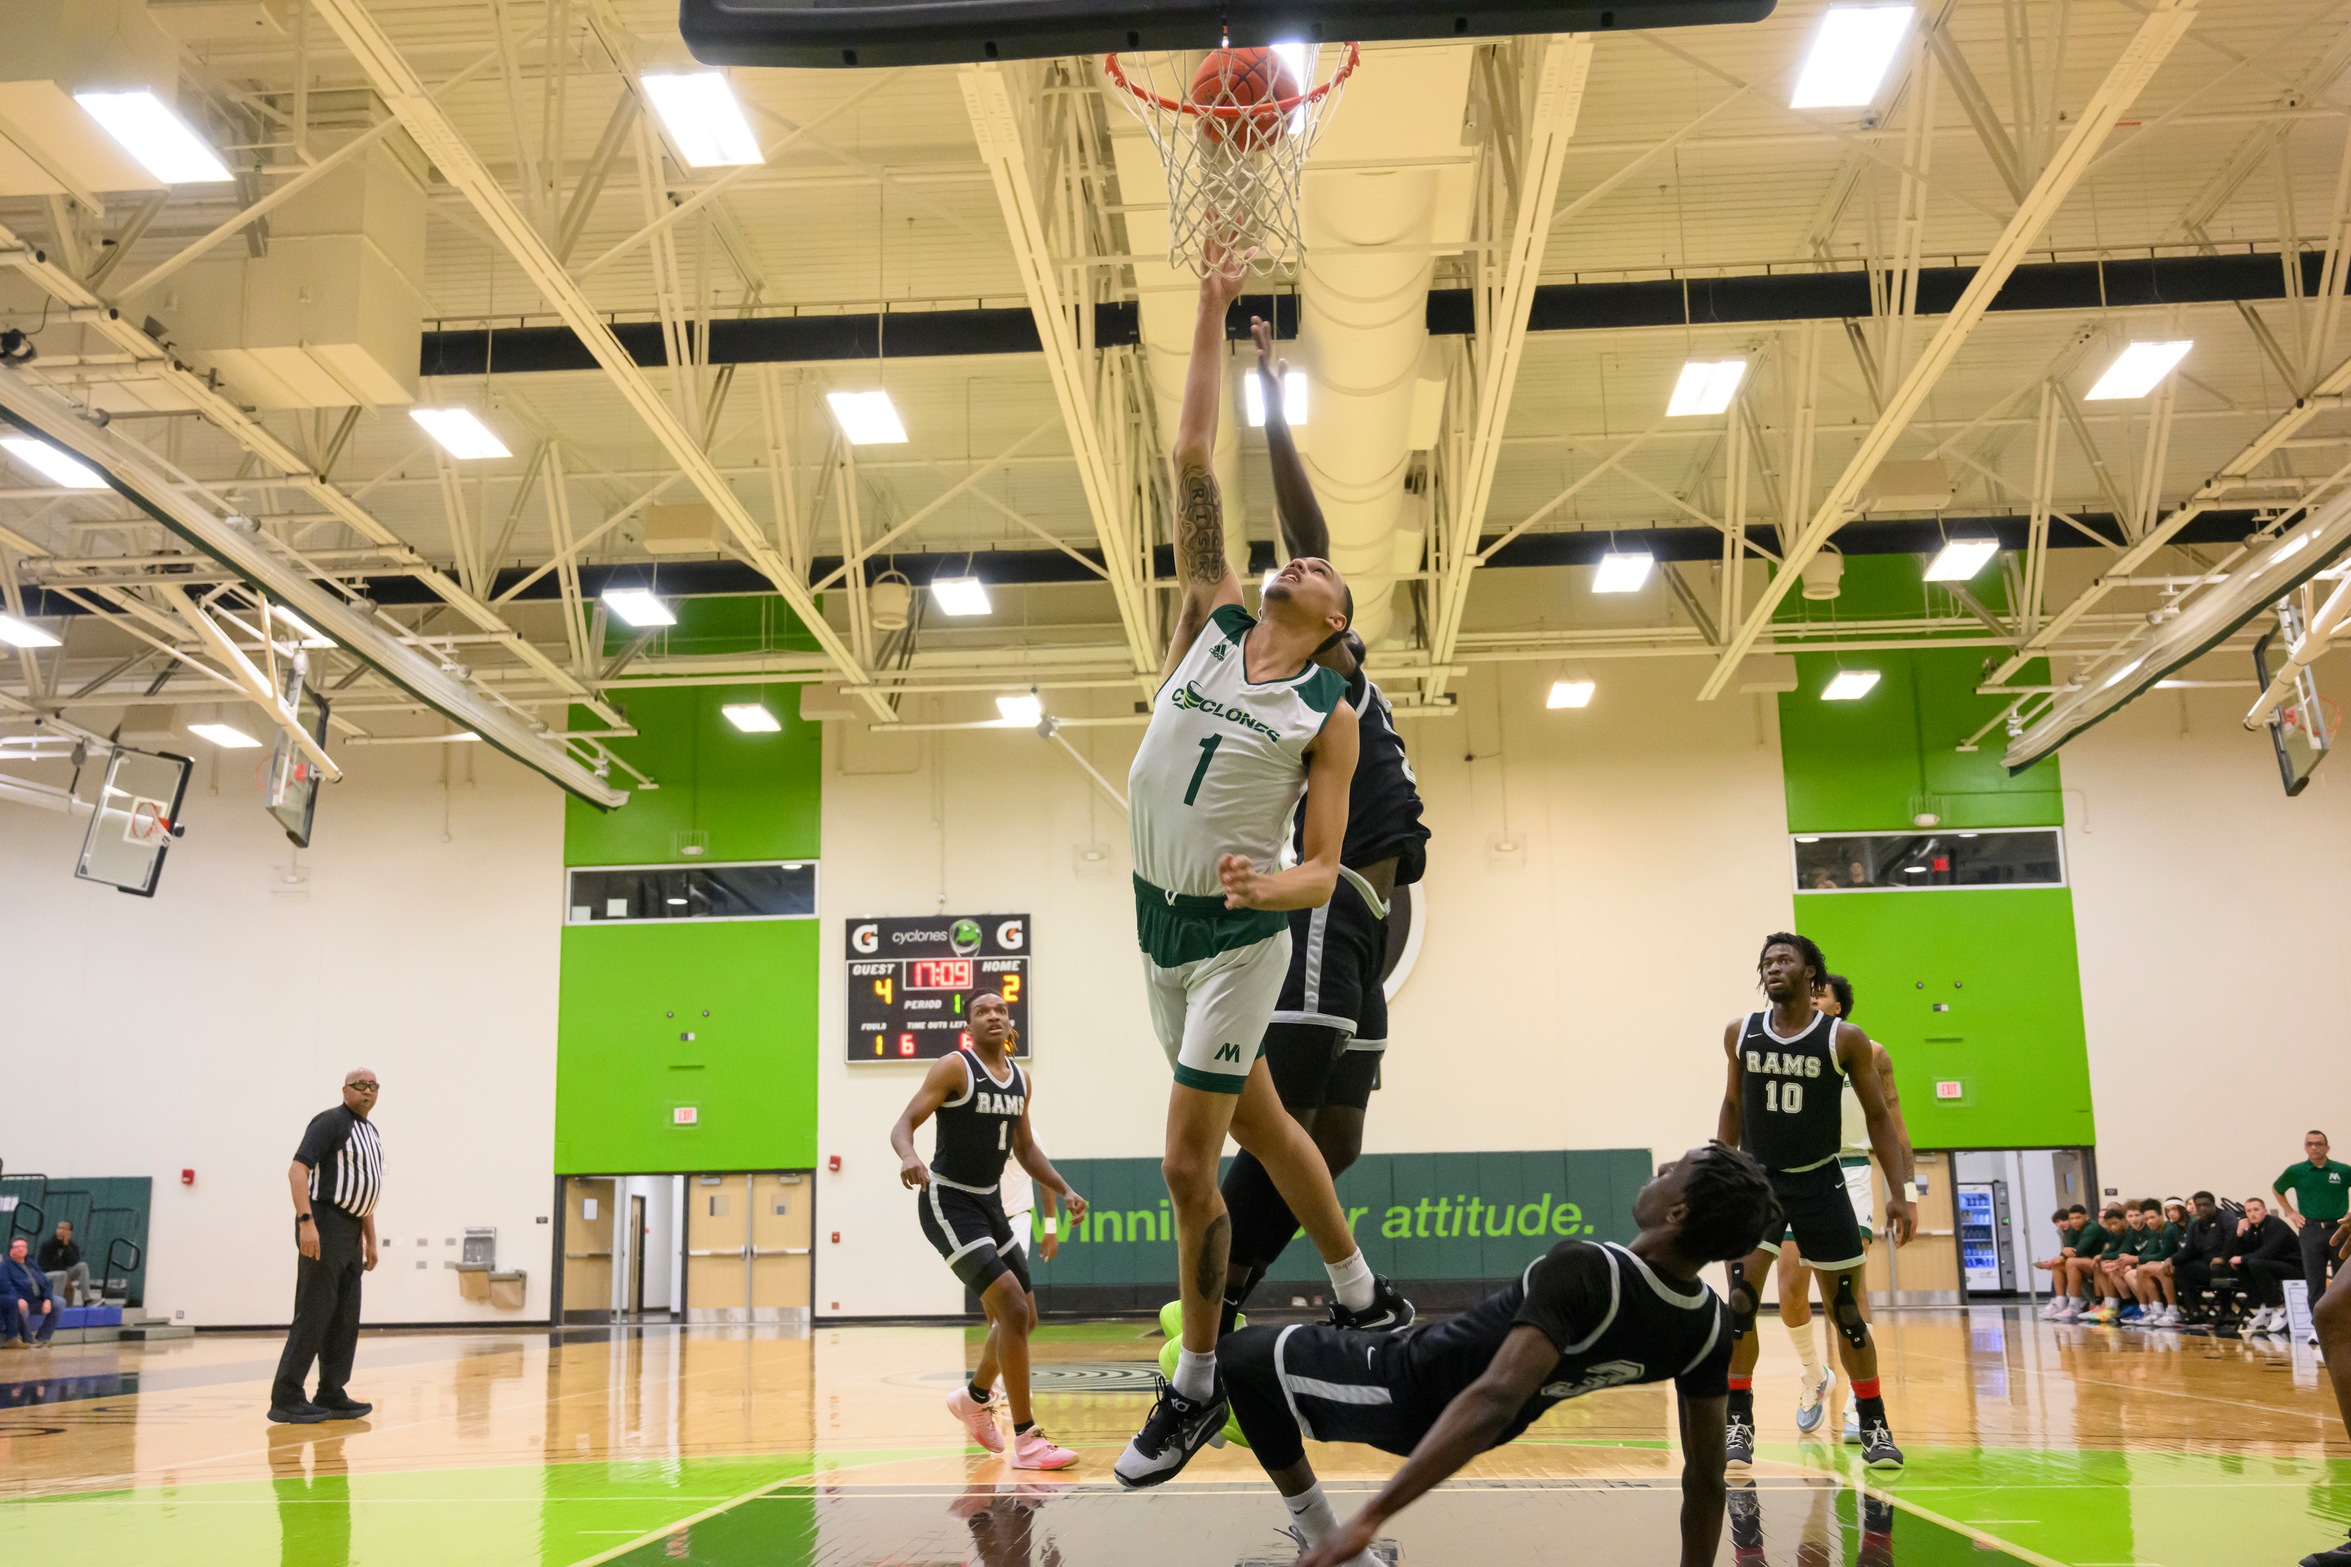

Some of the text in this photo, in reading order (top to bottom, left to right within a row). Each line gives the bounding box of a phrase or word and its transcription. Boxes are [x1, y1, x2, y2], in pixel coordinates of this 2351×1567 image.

[1183, 732, 1223, 807] 1
[852, 923, 879, 954] G
[892, 929, 948, 945] cyclones
[996, 920, 1023, 950] G
[852, 963, 896, 976] GUEST
[914, 961, 970, 988] 17:09
[982, 960, 1021, 972] HOME
[873, 978, 893, 1005] 4
[1002, 974, 1021, 1003] 2
[904, 999, 942, 1010] PERIOD
[953, 993, 962, 1014] 1
[861, 1022, 888, 1031] FOULS
[906, 1021, 926, 1030] TIME
[927, 1021, 947, 1029] OUTS
[875, 1035, 884, 1056] 1
[900, 1033, 915, 1056] 6
[1745, 1050, 1822, 1079] RAMS
[975, 1091, 1025, 1116] RAMS
[1765, 1080, 1803, 1114] 10
[998, 1120, 1009, 1151] 1
[1381, 1192, 1595, 1239] attitude.
